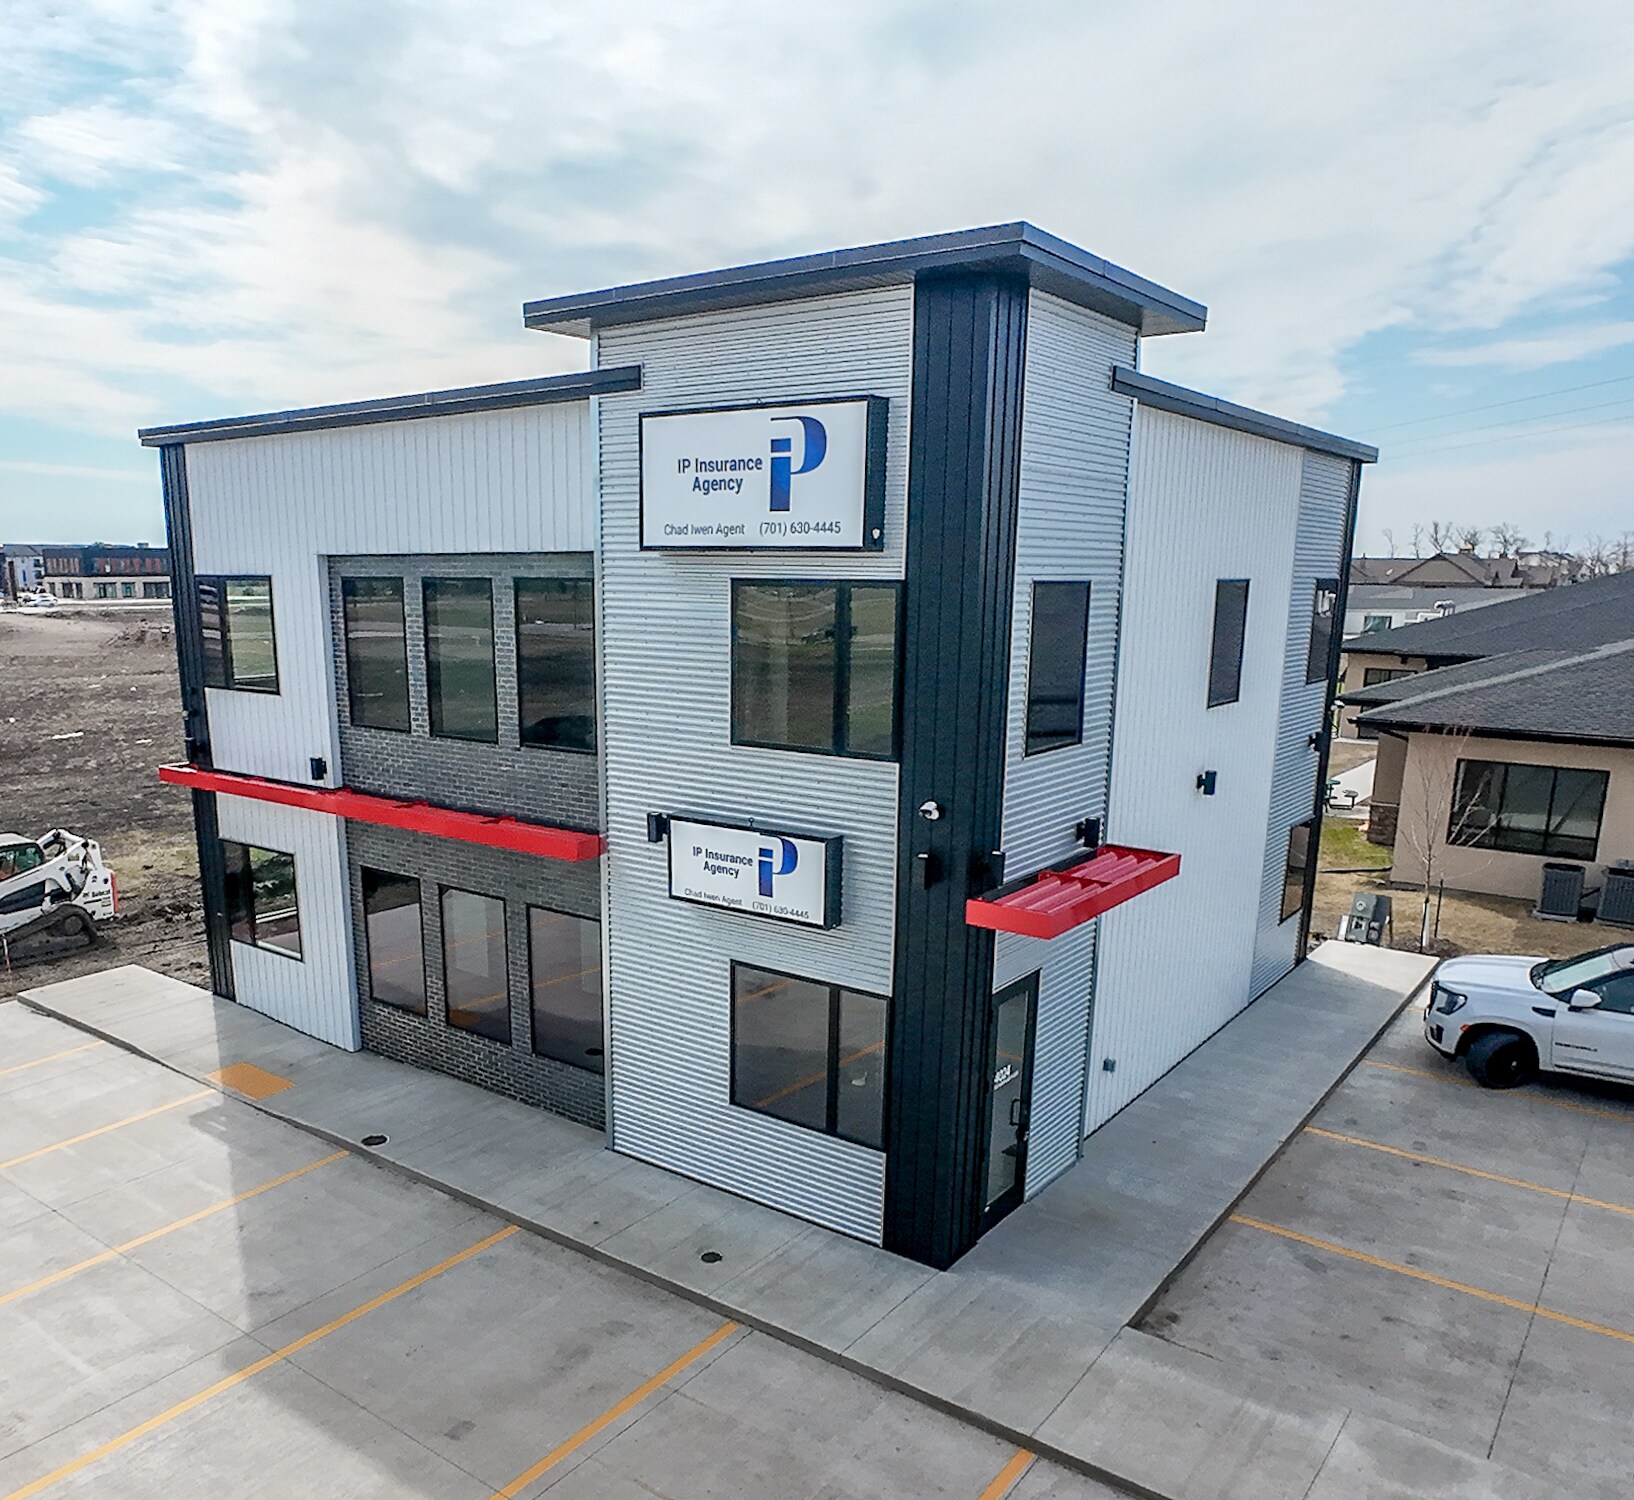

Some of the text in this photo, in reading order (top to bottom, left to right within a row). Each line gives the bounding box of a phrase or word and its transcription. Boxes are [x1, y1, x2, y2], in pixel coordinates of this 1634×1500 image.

[678, 457, 763, 474] IP Insurance
[692, 477, 744, 496] Agency
[664, 521, 842, 538] Chad Iwen Agent (701) 630-4445
[692, 845, 754, 867] IP Insurance
[703, 860, 740, 879] Agency
[722, 896, 743, 907] Agent
[752, 901, 772, 914] (701)
